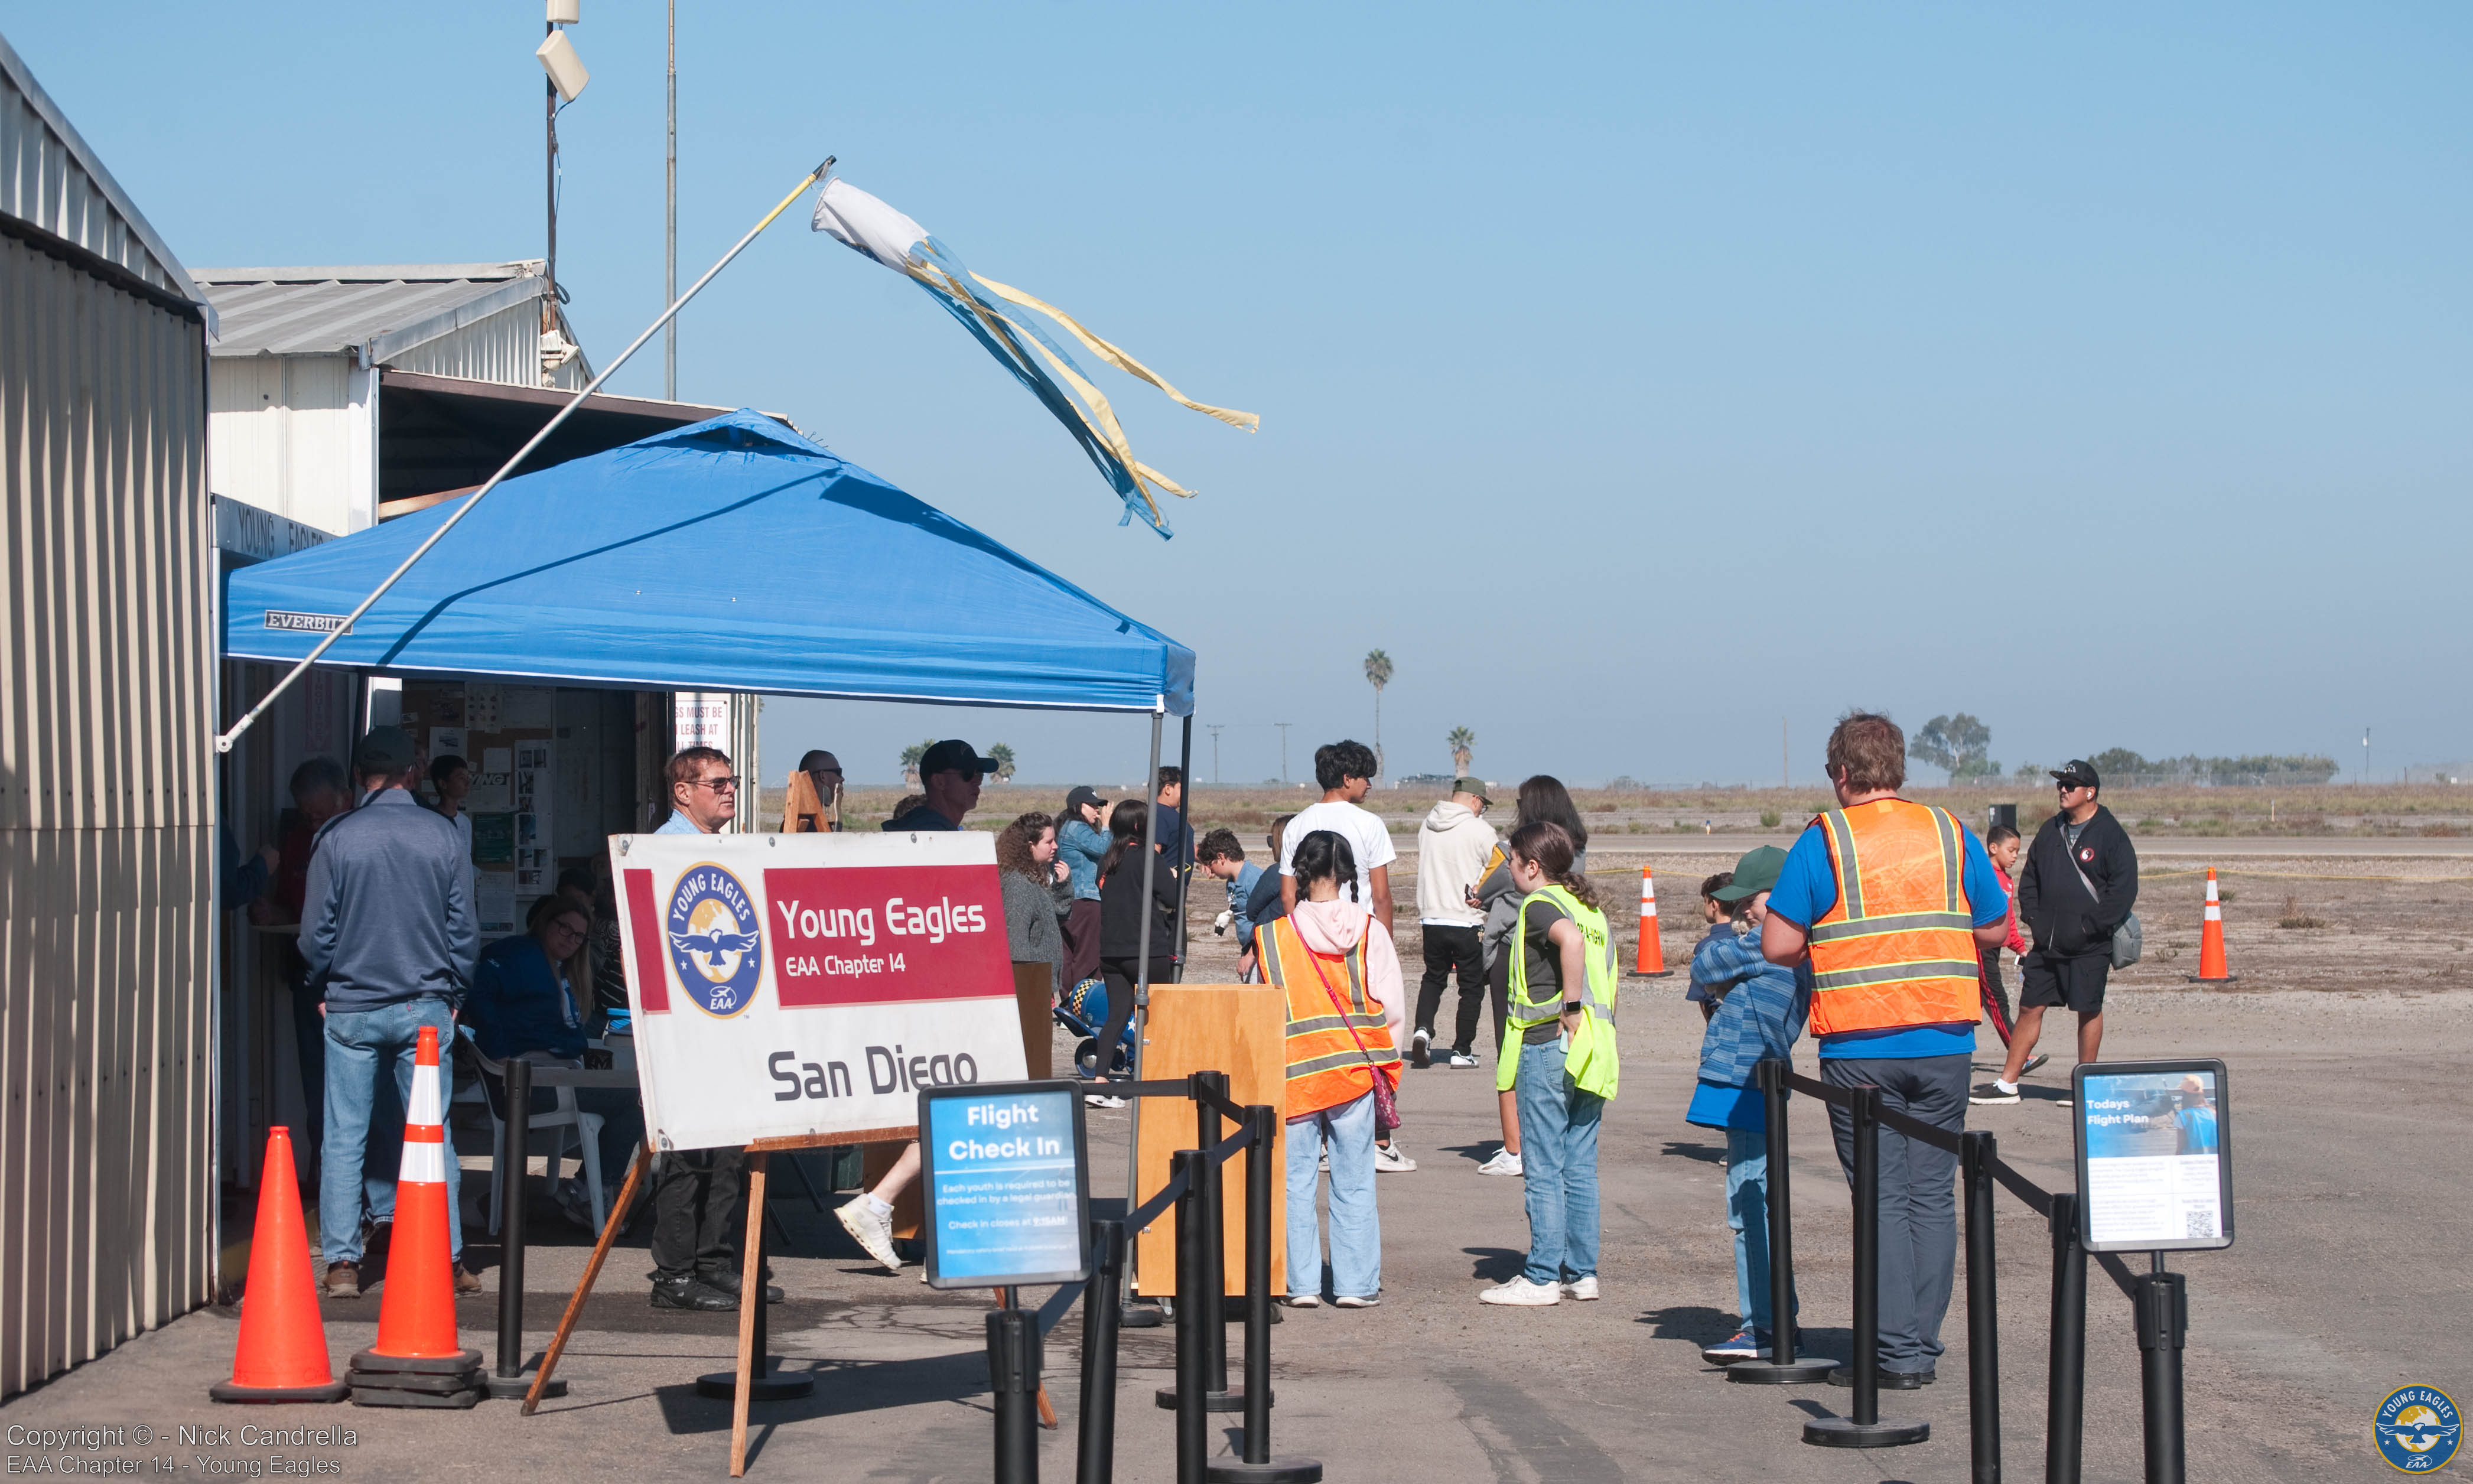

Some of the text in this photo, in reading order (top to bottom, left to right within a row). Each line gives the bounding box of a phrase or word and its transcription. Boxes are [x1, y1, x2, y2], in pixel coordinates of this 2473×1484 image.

[238, 505, 275, 558] YOUNG
[687, 707, 710, 718] MUST
[712, 707, 723, 718] BE
[681, 724, 718, 735] LEASH AT
[673, 873, 750, 922] YOUNG EAGLES
[776, 896, 986, 946] Young Eagles
[786, 952, 906, 978] EAA Chapter 14
[710, 997, 733, 1010] EAA
[768, 1044, 978, 1102] San Diego
[2087, 1099, 2130, 1111] Todays
[967, 1103, 1039, 1130] Flight
[2087, 1114, 2149, 1127] Flight Plan
[948, 1137, 1060, 1160] Check In
[942, 1179, 1070, 1194] Each youth is required to be
[936, 1195, 977, 1206] checked
[978, 1195, 988, 1203] in
[988, 1194, 1001, 1205] by
[1009, 1193, 1031, 1205] legal
[948, 1219, 978, 1230] Check
[990, 1218, 1019, 1229] closes
[1021, 1218, 1032, 1226] at
